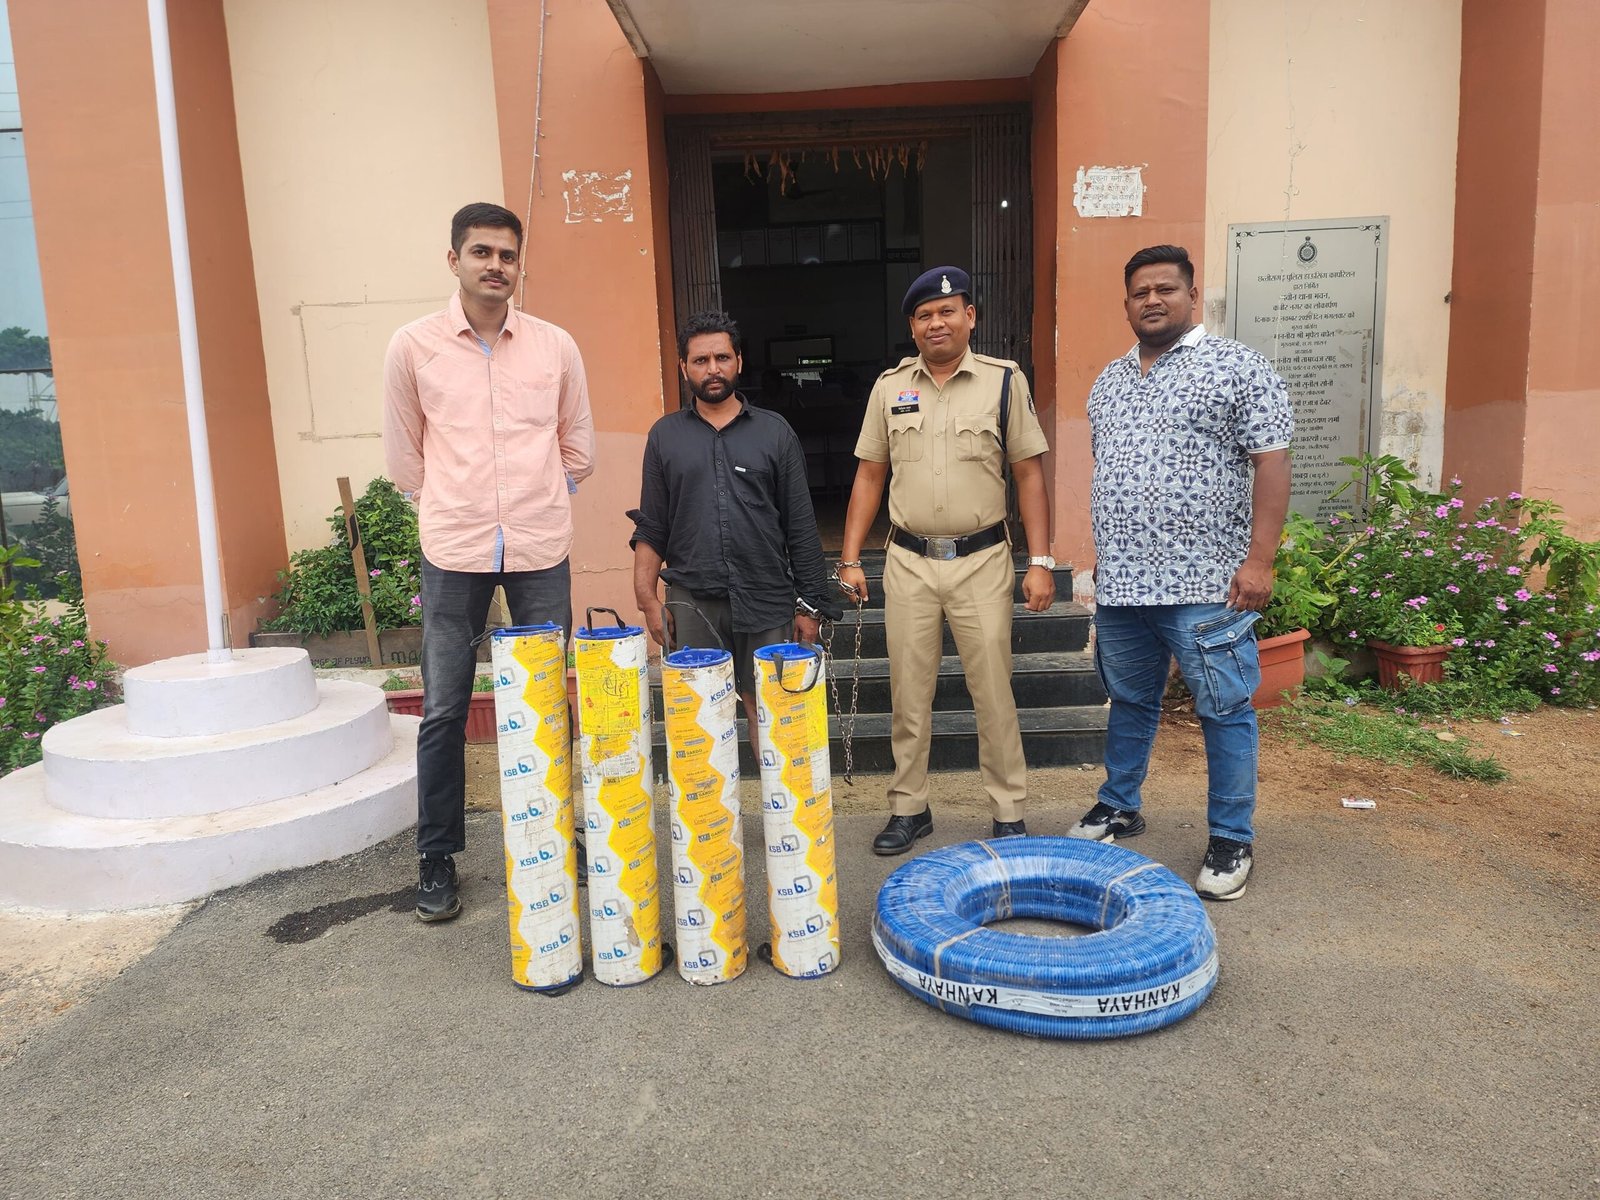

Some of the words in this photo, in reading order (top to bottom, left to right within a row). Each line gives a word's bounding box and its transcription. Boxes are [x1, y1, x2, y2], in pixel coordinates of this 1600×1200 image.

[710, 689, 726, 702] KSB
[721, 728, 734, 741] KSB
[510, 812, 528, 822] KSB
[769, 845, 782, 853] KSB
[520, 856, 538, 868] KSB
[777, 888, 794, 896] KSB
[530, 900, 550, 911] KSB
[788, 930, 806, 938] KSB
[540, 941, 560, 954] KSB
[598, 952, 612, 960] KSB
[684, 960, 698, 968] KSB
[918, 973, 998, 1004] KANHAYA
[1097, 982, 1180, 1013] KANHAYA
